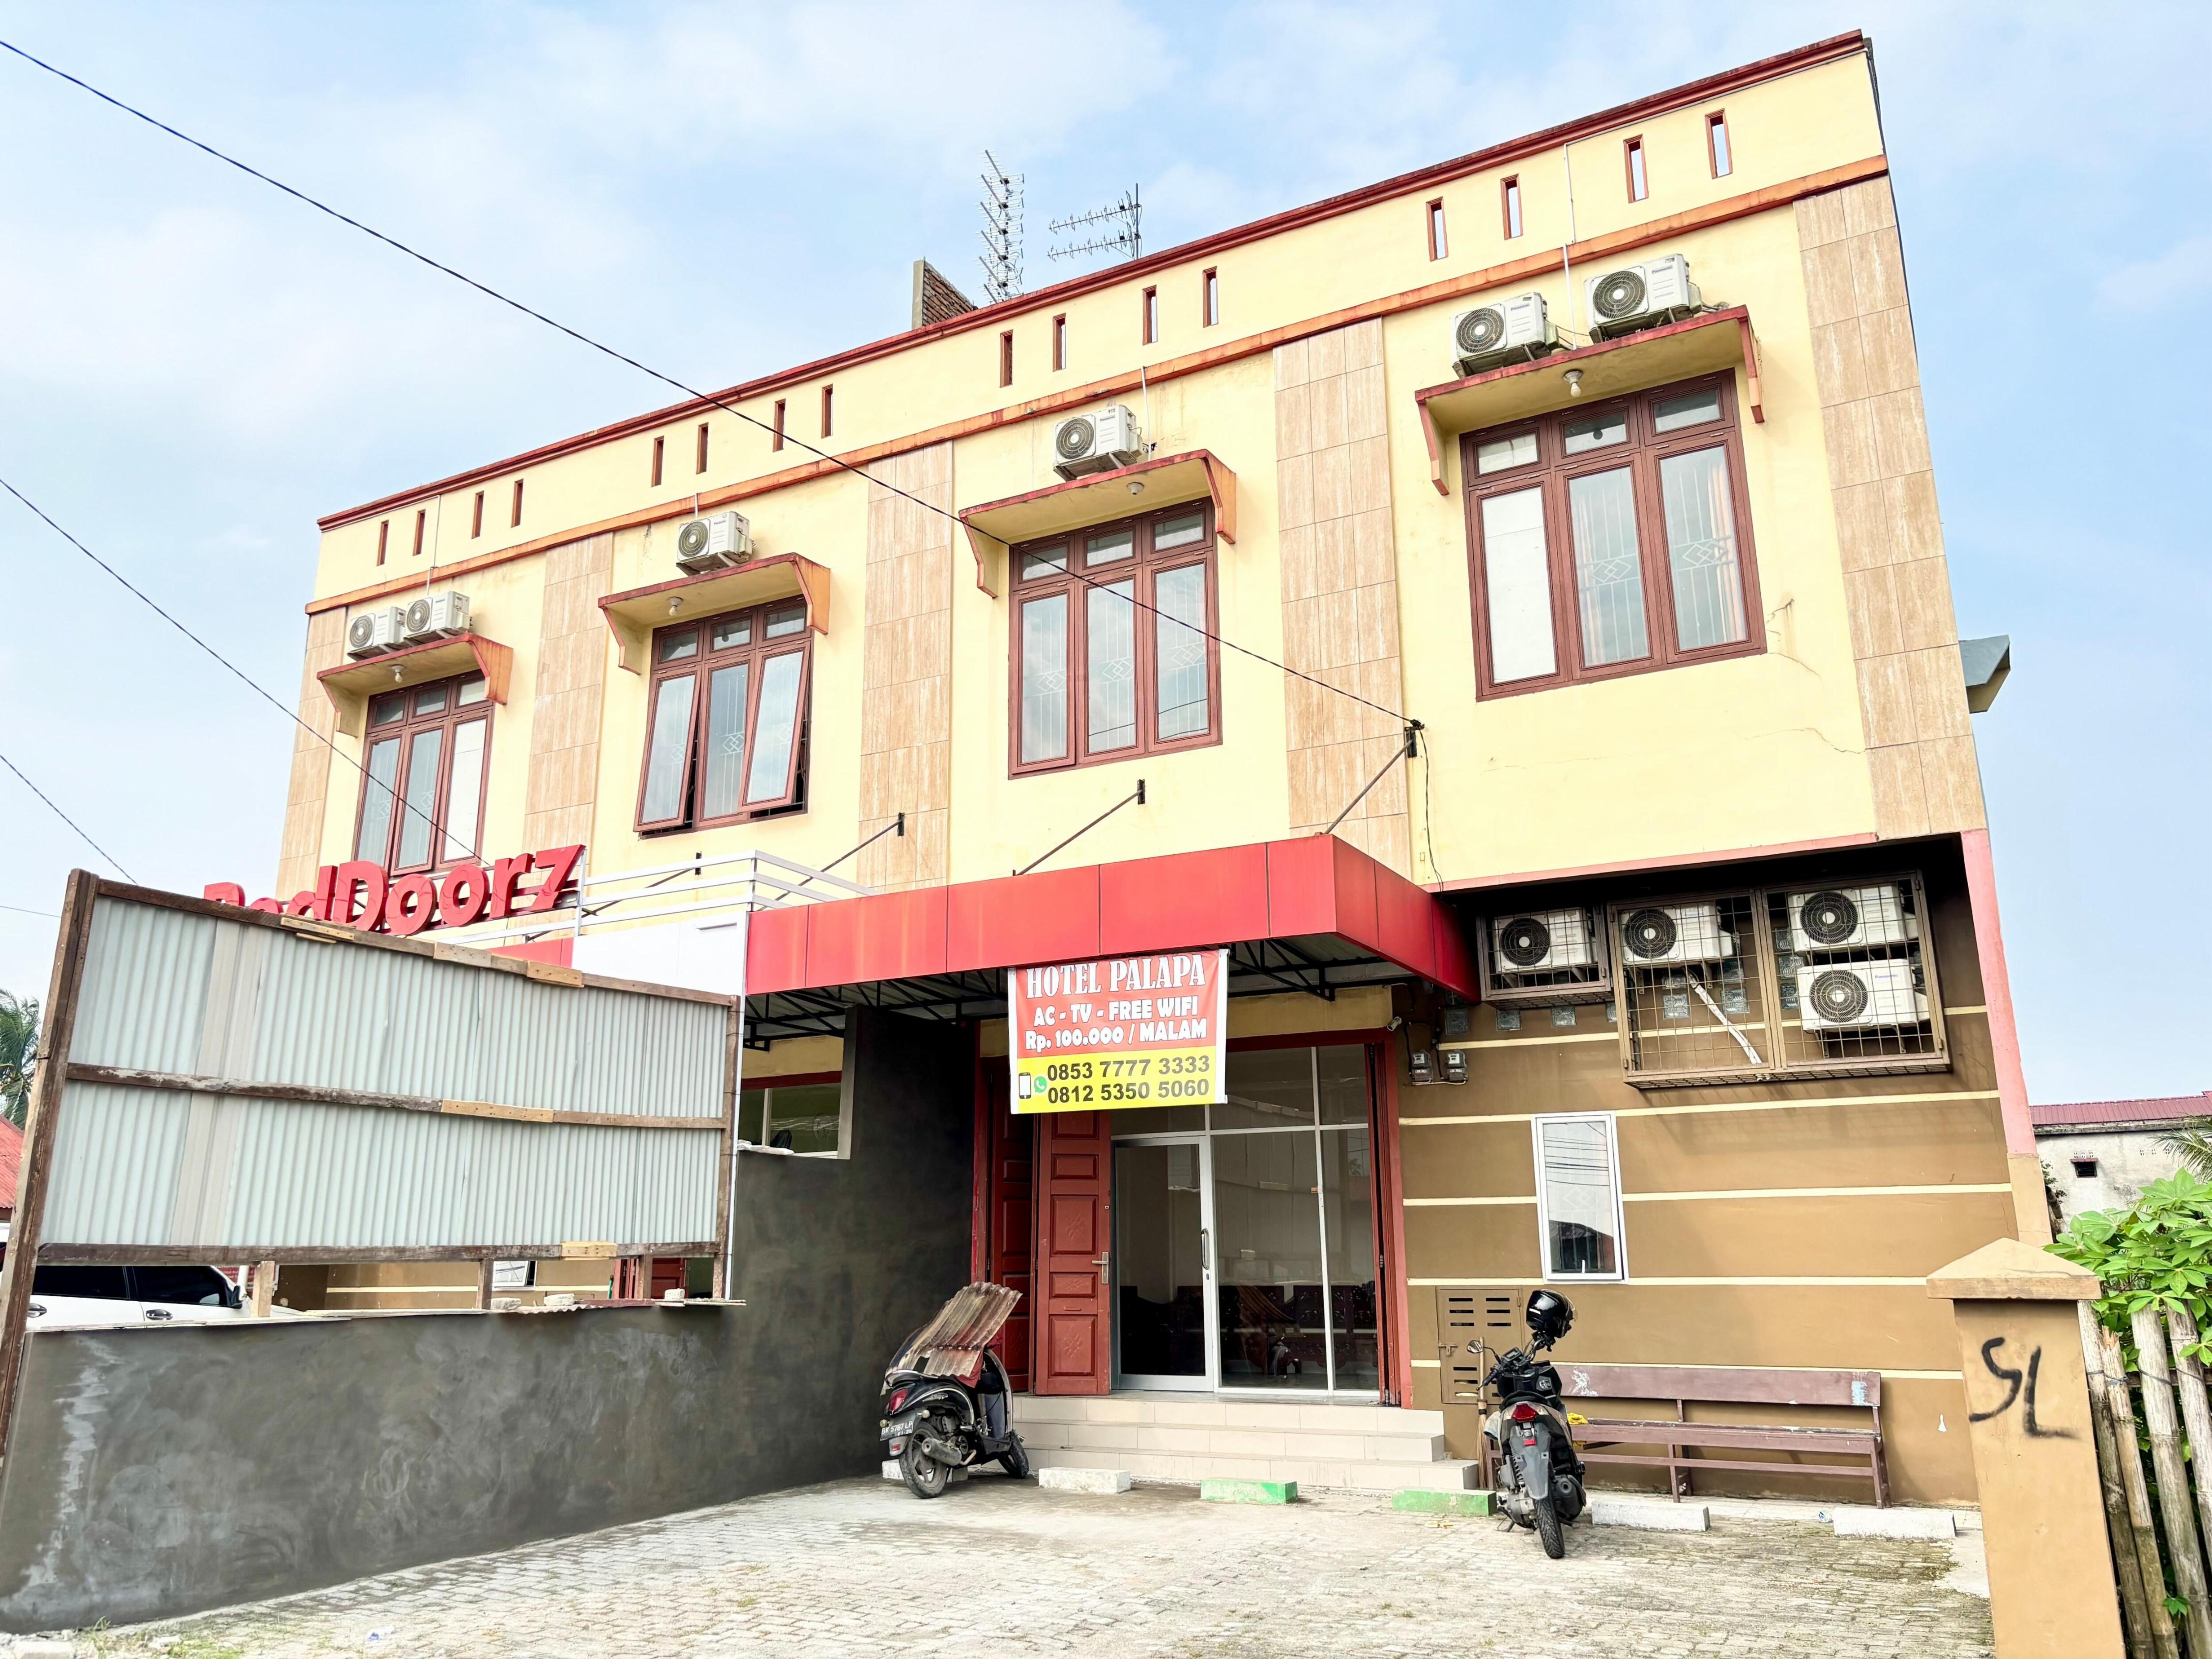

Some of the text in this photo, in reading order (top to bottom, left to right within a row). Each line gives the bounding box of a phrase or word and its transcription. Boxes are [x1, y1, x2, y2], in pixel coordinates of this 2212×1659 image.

[1026, 954, 1206, 999] HOTEL PALAPA
[1033, 1005, 1056, 1027] AC
[1070, 1003, 1093, 1023] TV
[1108, 999, 1153, 1021] FREE
[1156, 995, 1198, 1017] WIFI
[1025, 1029, 1052, 1053] Rp.
[1055, 1026, 1124, 1048] 100.000
[1138, 1018, 1207, 1043] MALAM
[1047, 1055, 1210, 1081] 0853 7777 3333
[1048, 1078, 1209, 1104] 0812 5350 5060
[891, 1423, 904, 1432] 5787
[905, 1421, 913, 1429] LP
